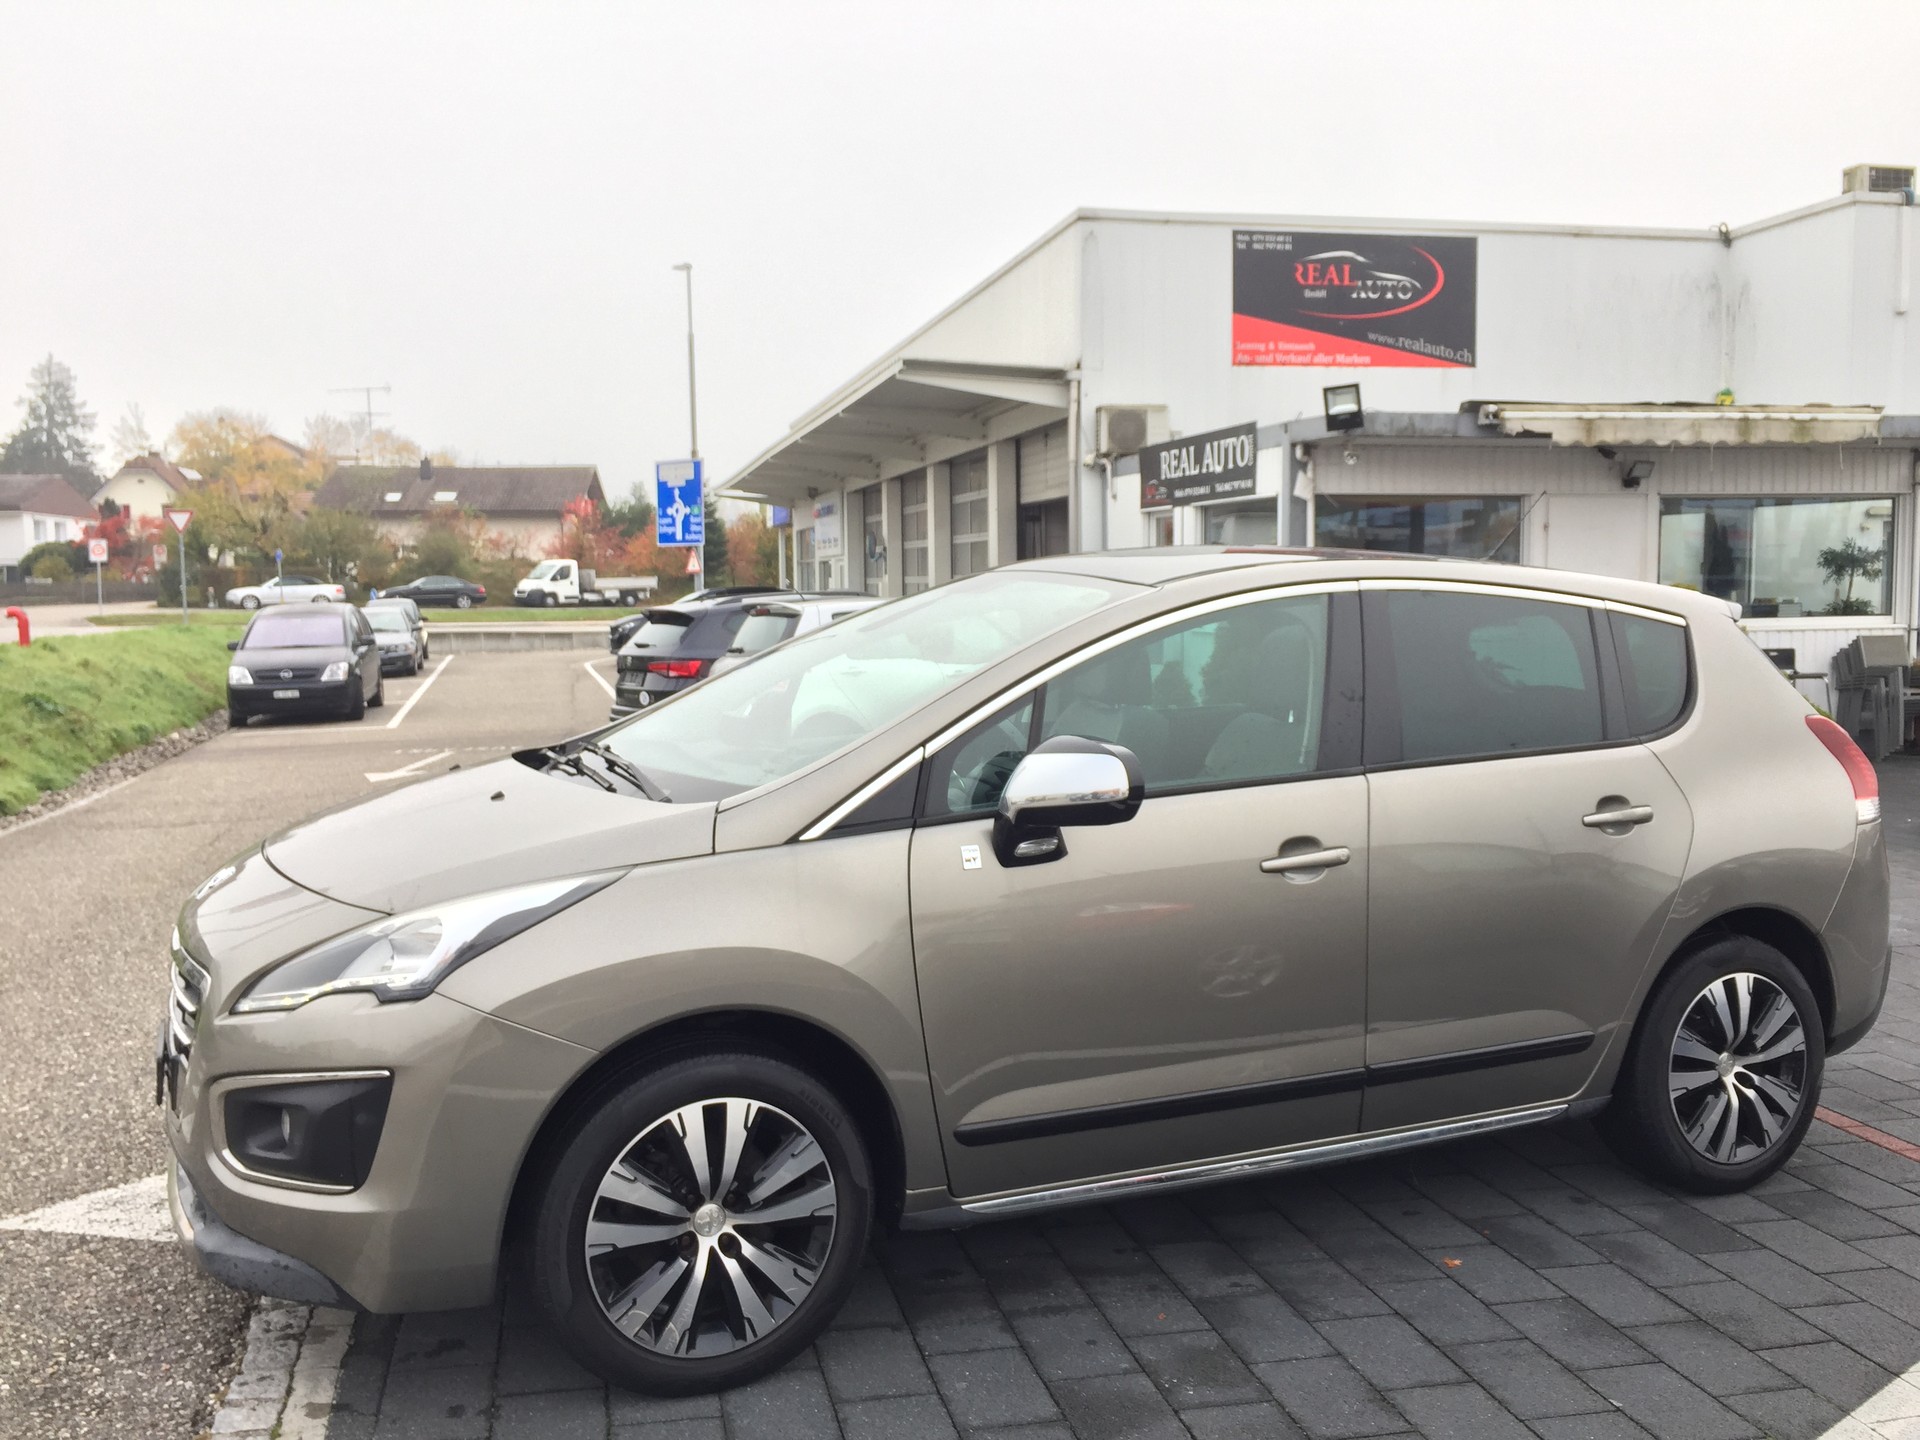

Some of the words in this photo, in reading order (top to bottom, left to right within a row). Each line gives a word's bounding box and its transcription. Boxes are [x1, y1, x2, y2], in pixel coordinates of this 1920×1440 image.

[1294, 262, 1358, 286] REAL
[1350, 280, 1413, 300] AUTO
[1255, 353, 1273, 363] und
[1275, 353, 1311, 364] Verkauf
[1313, 353, 1333, 364] aller
[1335, 354, 1371, 364] Marken
[1367, 331, 1473, 363] www.realauto.ch
[1159, 445, 1200, 480] REAL
[1201, 434, 1250, 475] AUTO
